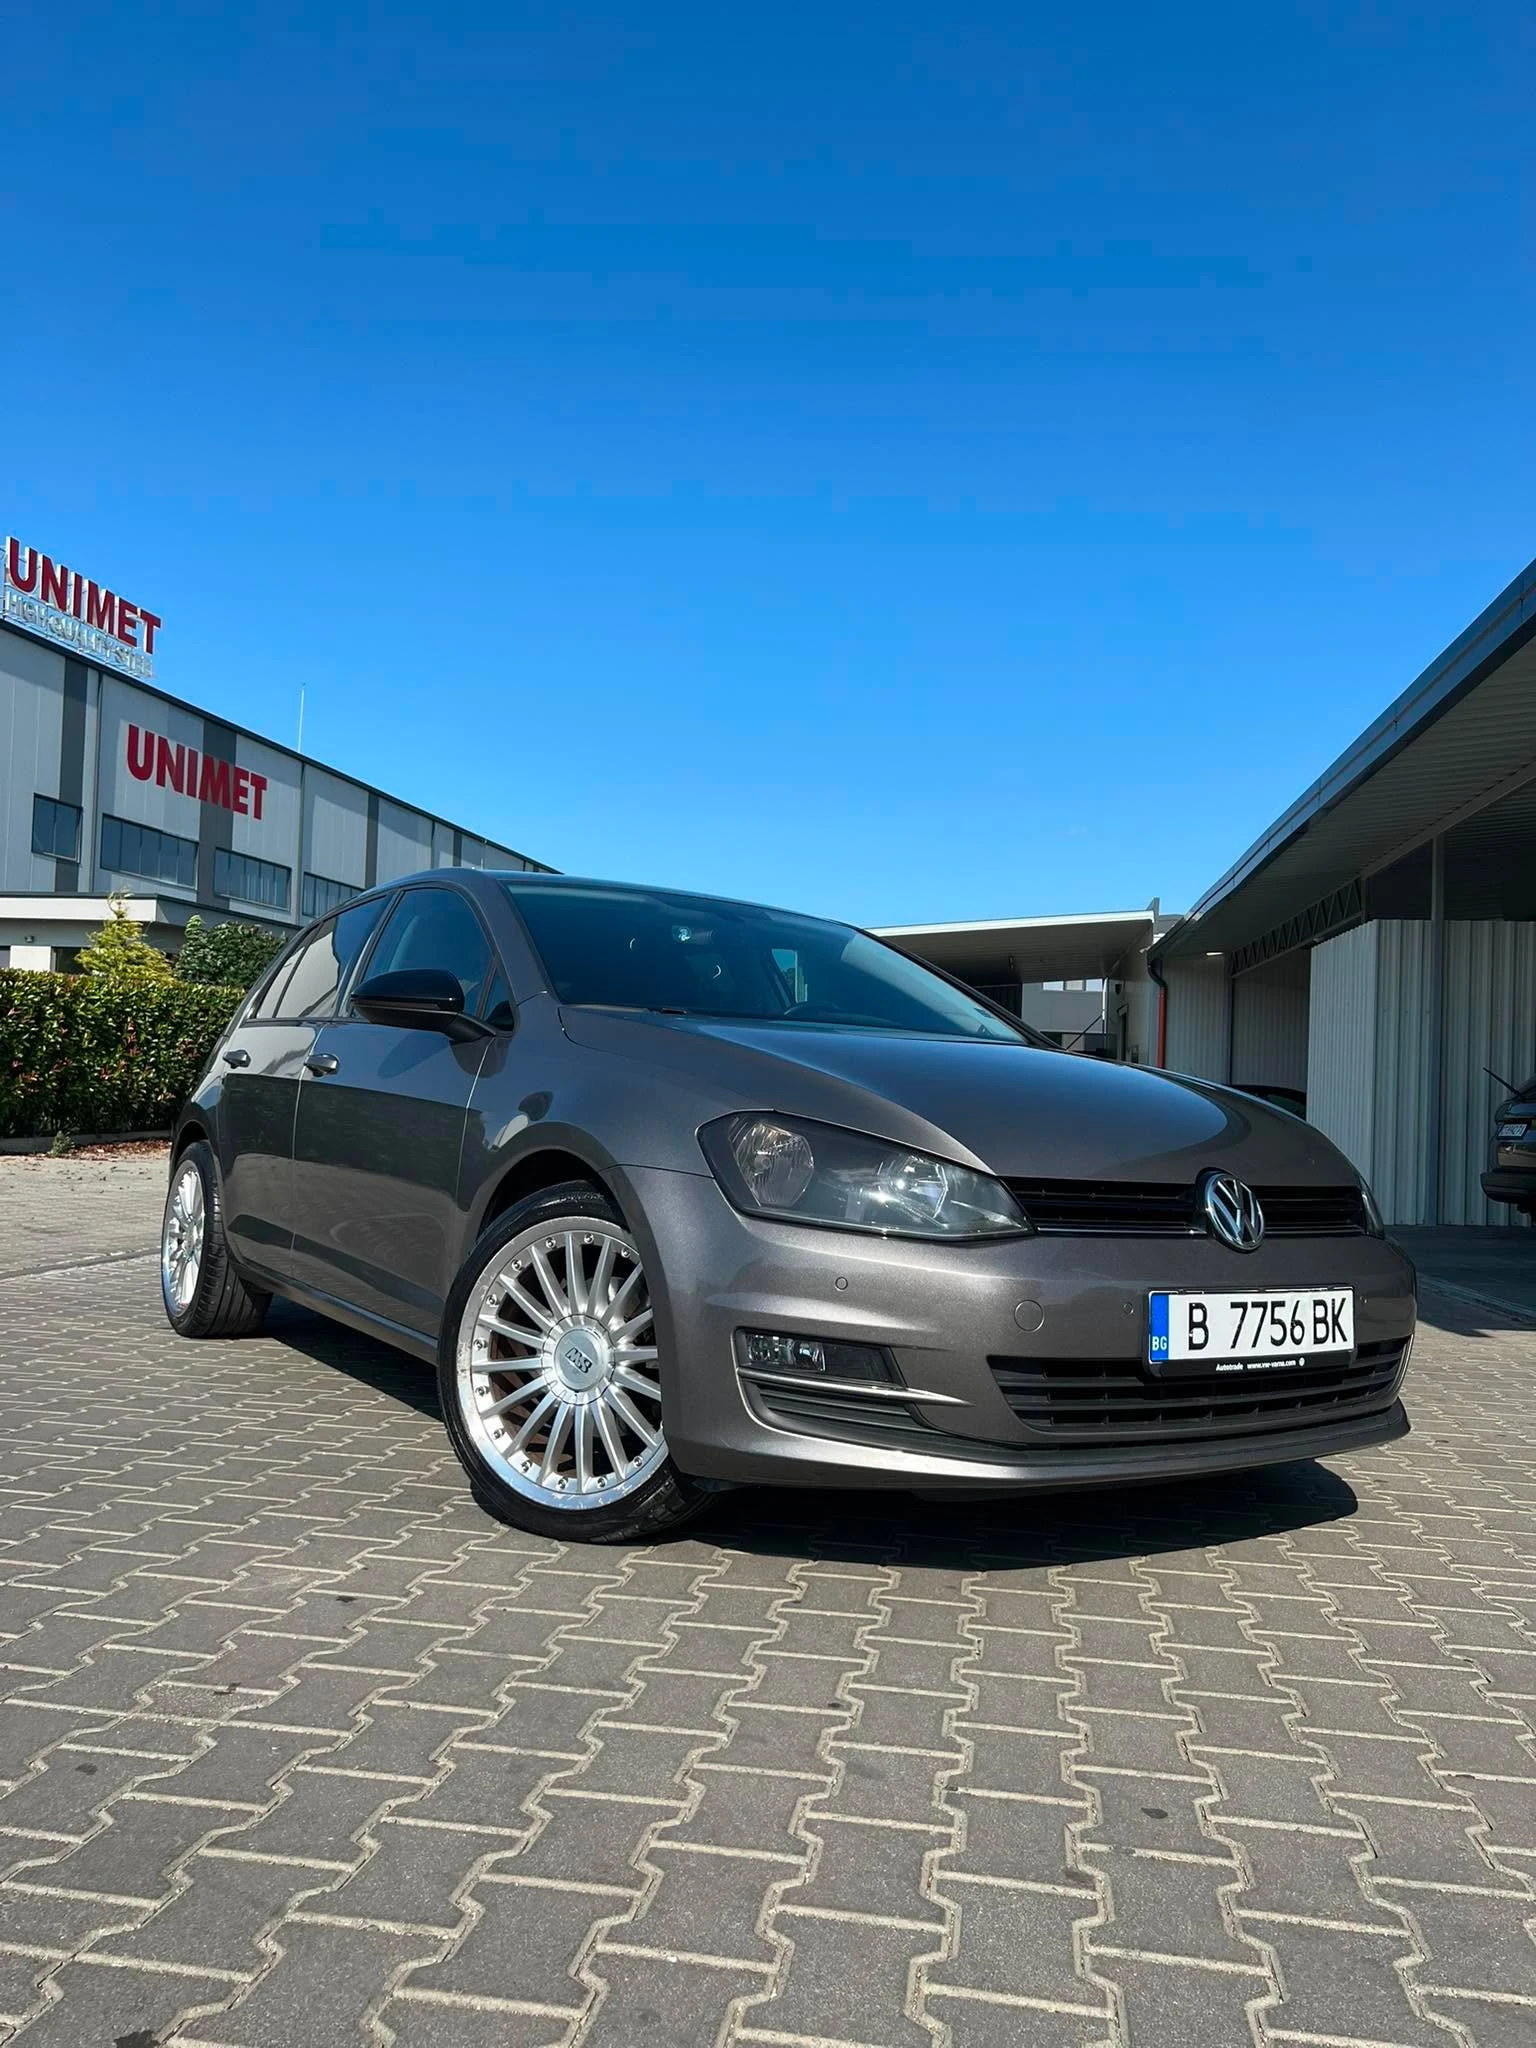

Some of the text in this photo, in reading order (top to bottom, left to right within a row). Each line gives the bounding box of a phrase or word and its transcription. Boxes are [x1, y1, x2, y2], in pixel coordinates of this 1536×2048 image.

[6, 536, 161, 655] UNIMET
[127, 723, 268, 820] UNIMET
[1152, 1336, 1168, 1351] BG
[1188, 1297, 1348, 1351] B 7756 BK
[1215, 1362, 1244, 1371] Autotrade
